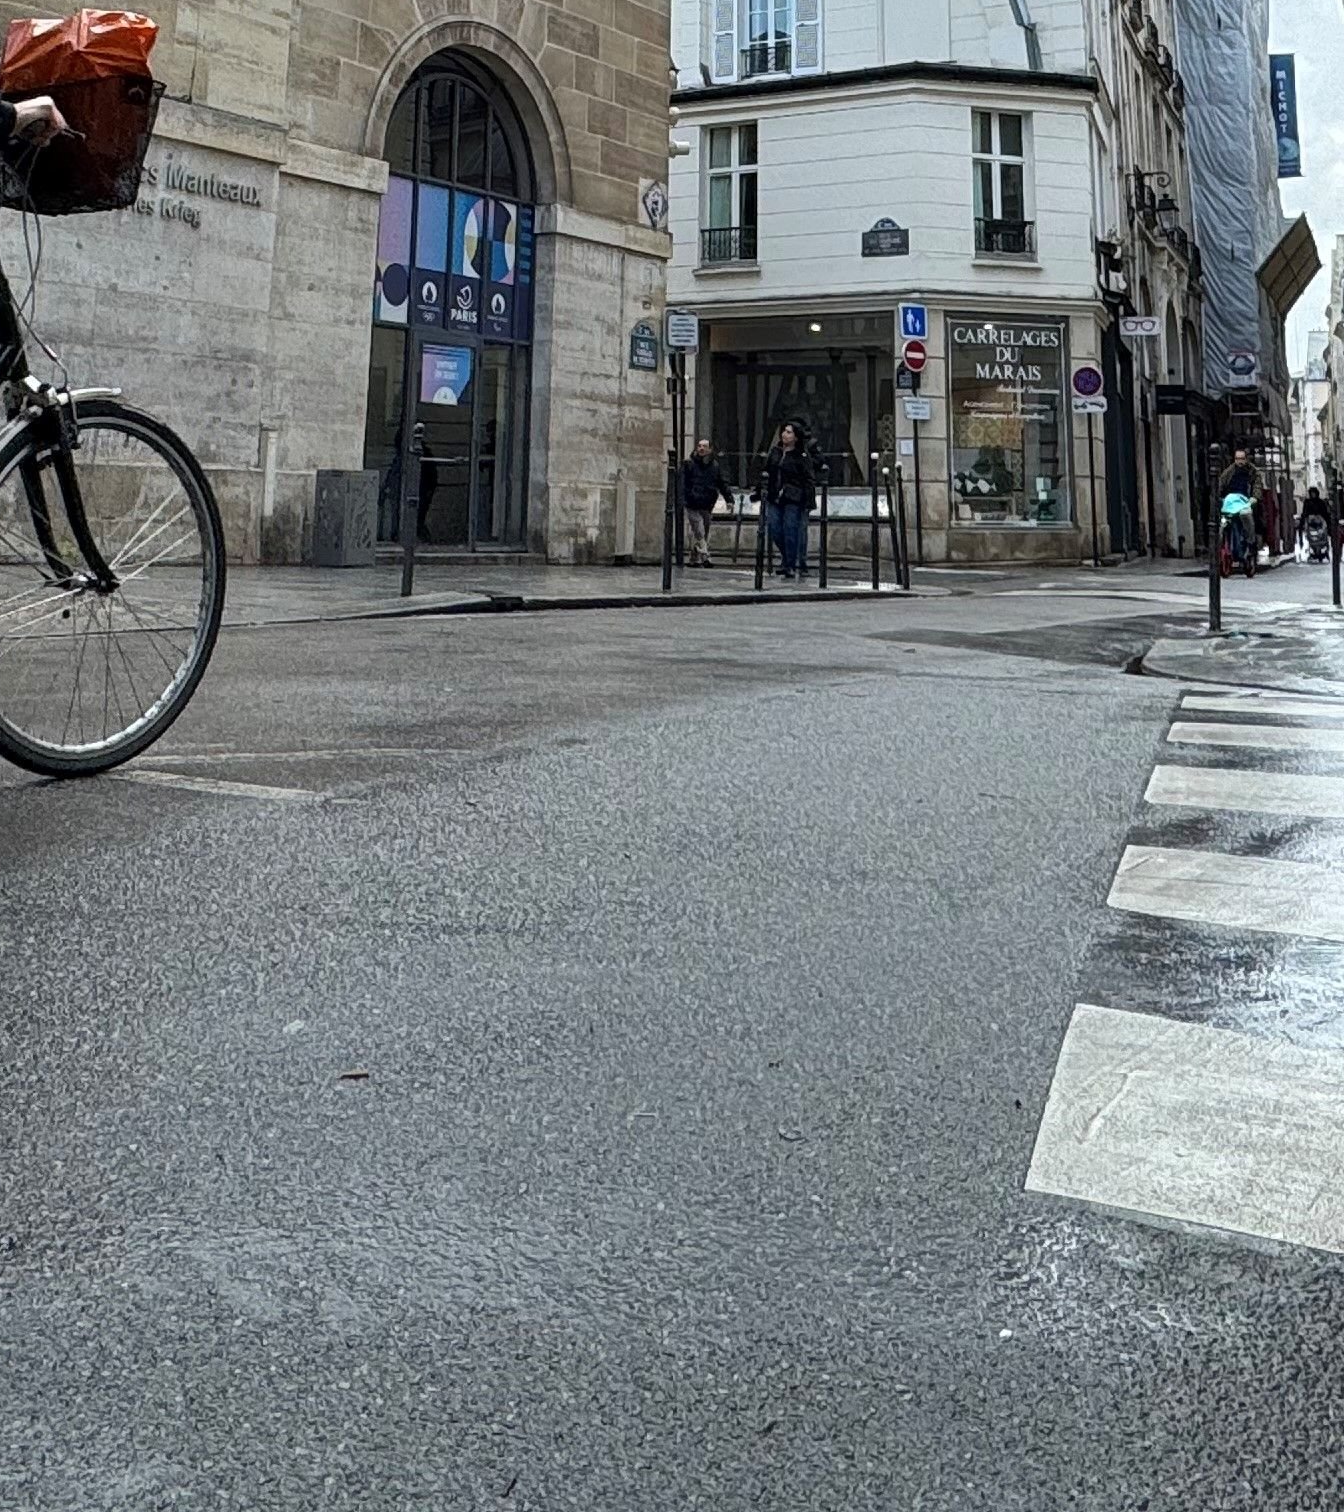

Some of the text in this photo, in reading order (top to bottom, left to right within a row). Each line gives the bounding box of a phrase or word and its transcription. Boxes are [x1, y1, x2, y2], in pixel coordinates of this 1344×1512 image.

[450, 308, 478, 324] PARIS
[953, 327, 1059, 348] CARRELAGES
[995, 346, 1020, 363] DU
[975, 363, 1042, 381] MARAIS
